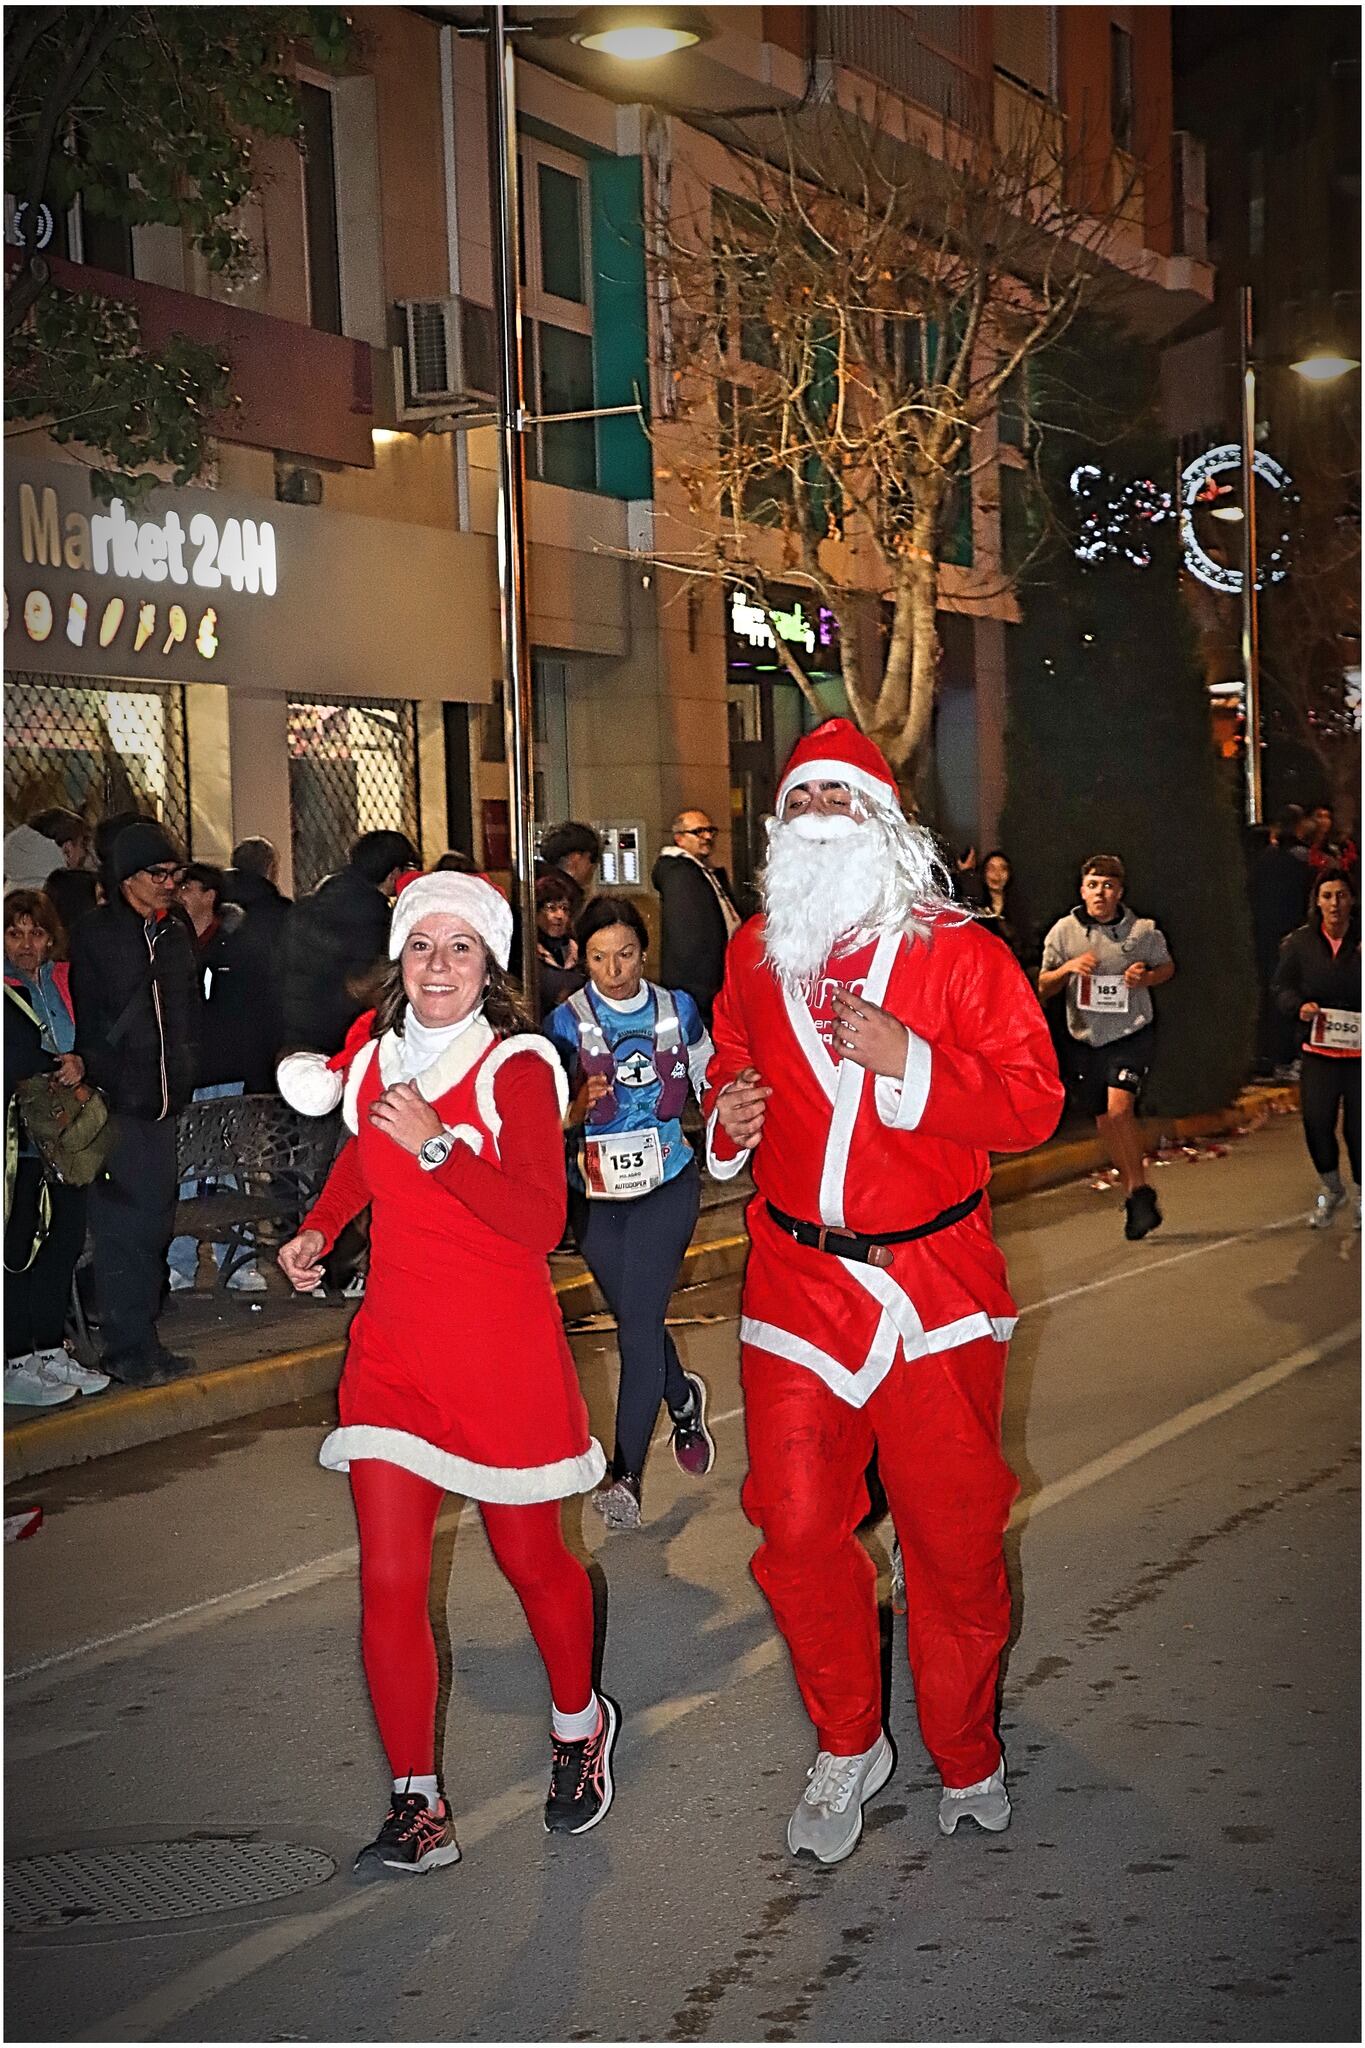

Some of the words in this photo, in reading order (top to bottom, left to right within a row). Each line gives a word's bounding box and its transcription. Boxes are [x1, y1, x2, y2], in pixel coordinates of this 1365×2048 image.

[19, 484, 189, 585] Market
[189, 513, 278, 596] 24H
[1097, 986, 1117, 995] 183
[1327, 1021, 1359, 1034] 2050
[610, 1151, 644, 1171] 153
